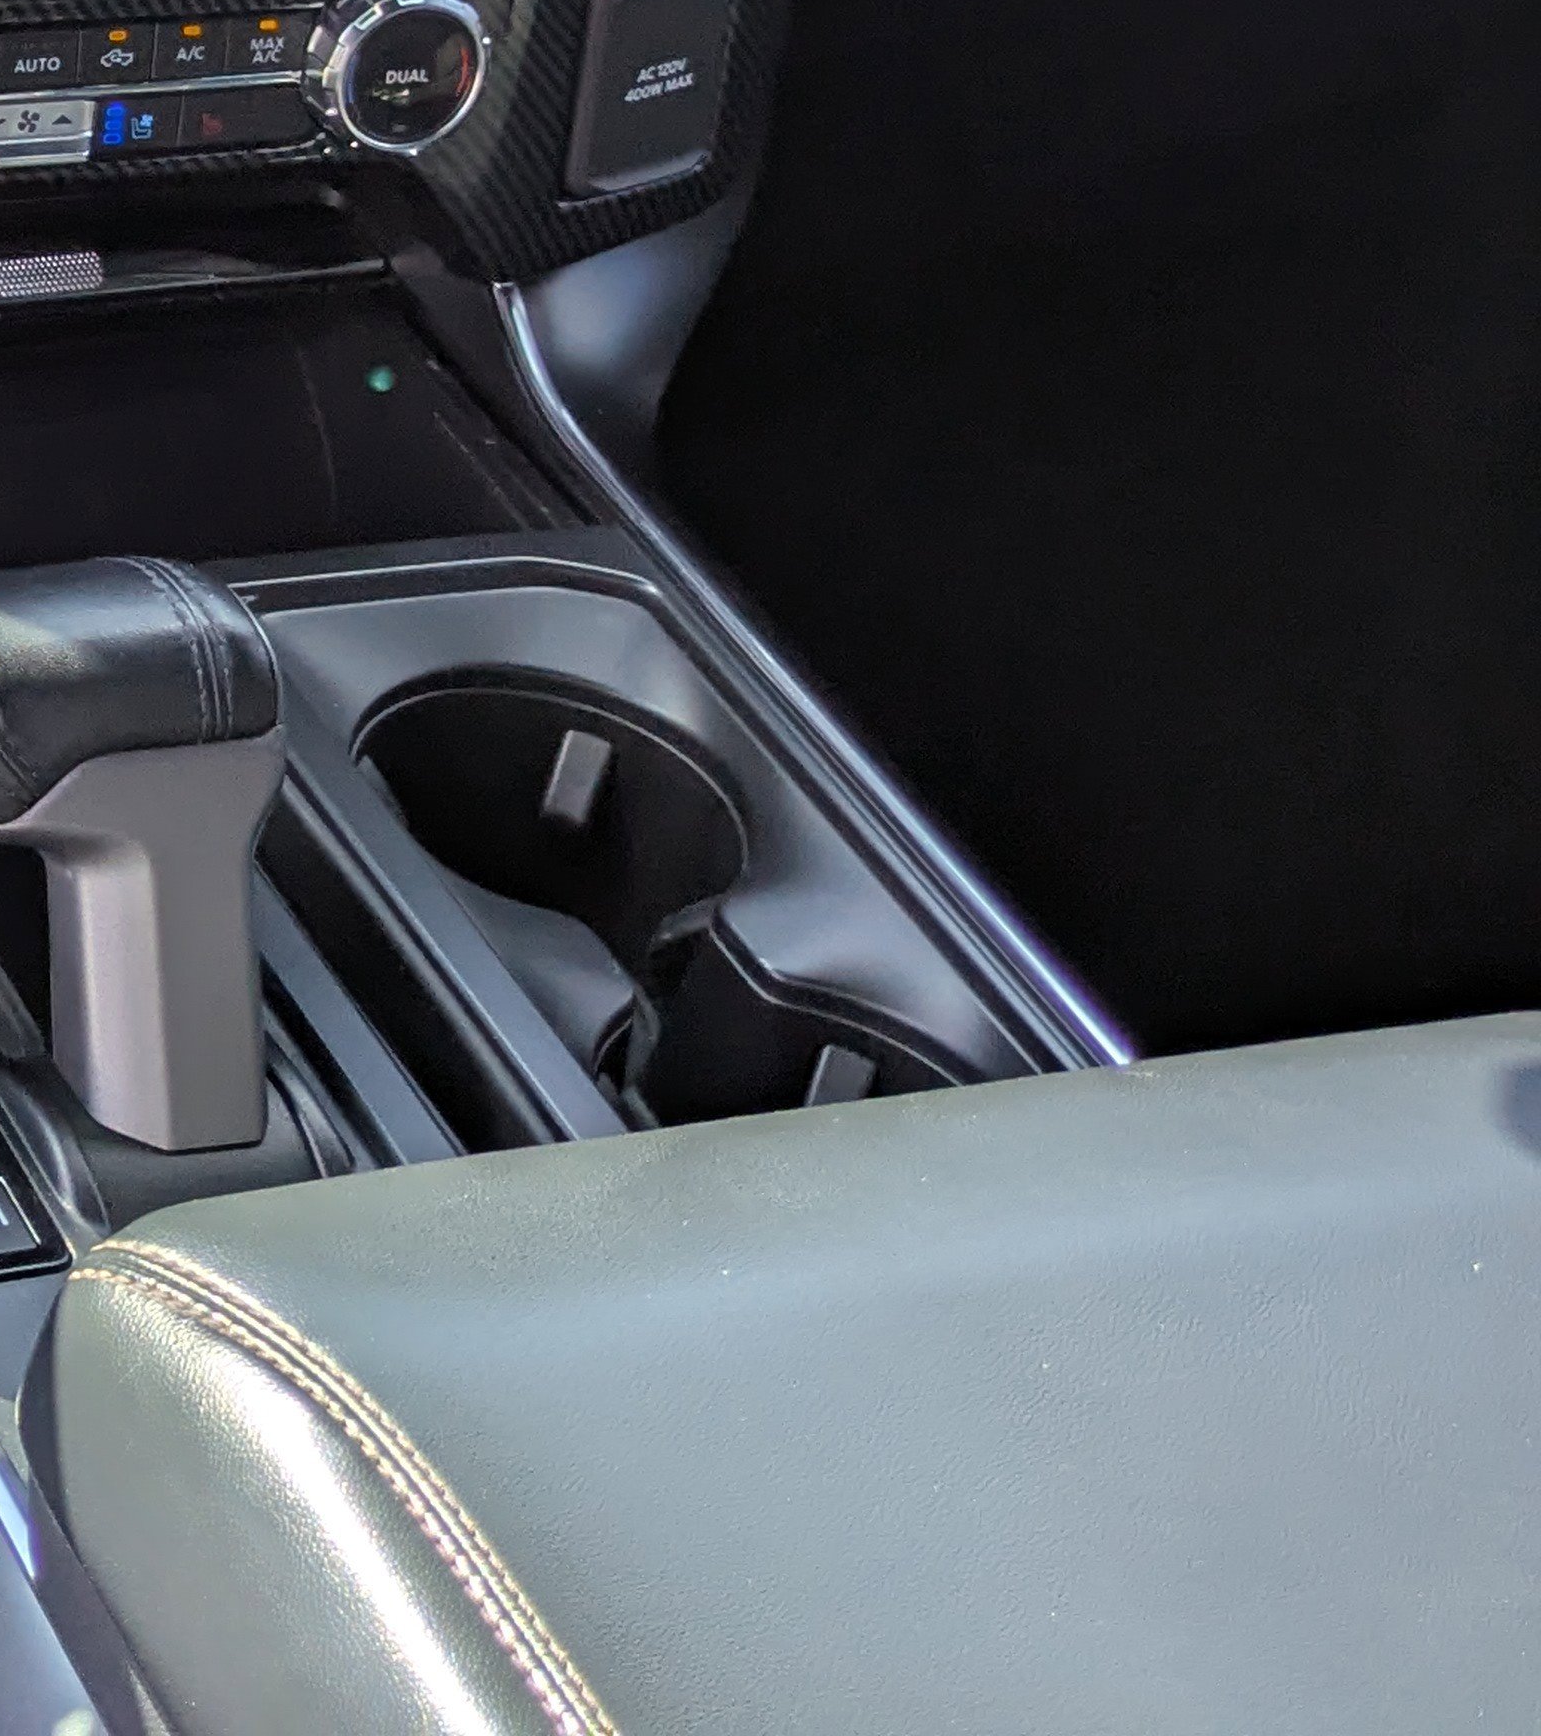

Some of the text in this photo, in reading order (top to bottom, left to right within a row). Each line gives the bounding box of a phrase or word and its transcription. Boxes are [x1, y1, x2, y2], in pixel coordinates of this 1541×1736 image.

[250, 36, 284, 51] MAX
[175, 45, 206, 61] A/C
[251, 49, 281, 63] A/C
[14, 56, 61, 73] AUTO
[385, 69, 430, 84] DUAL
